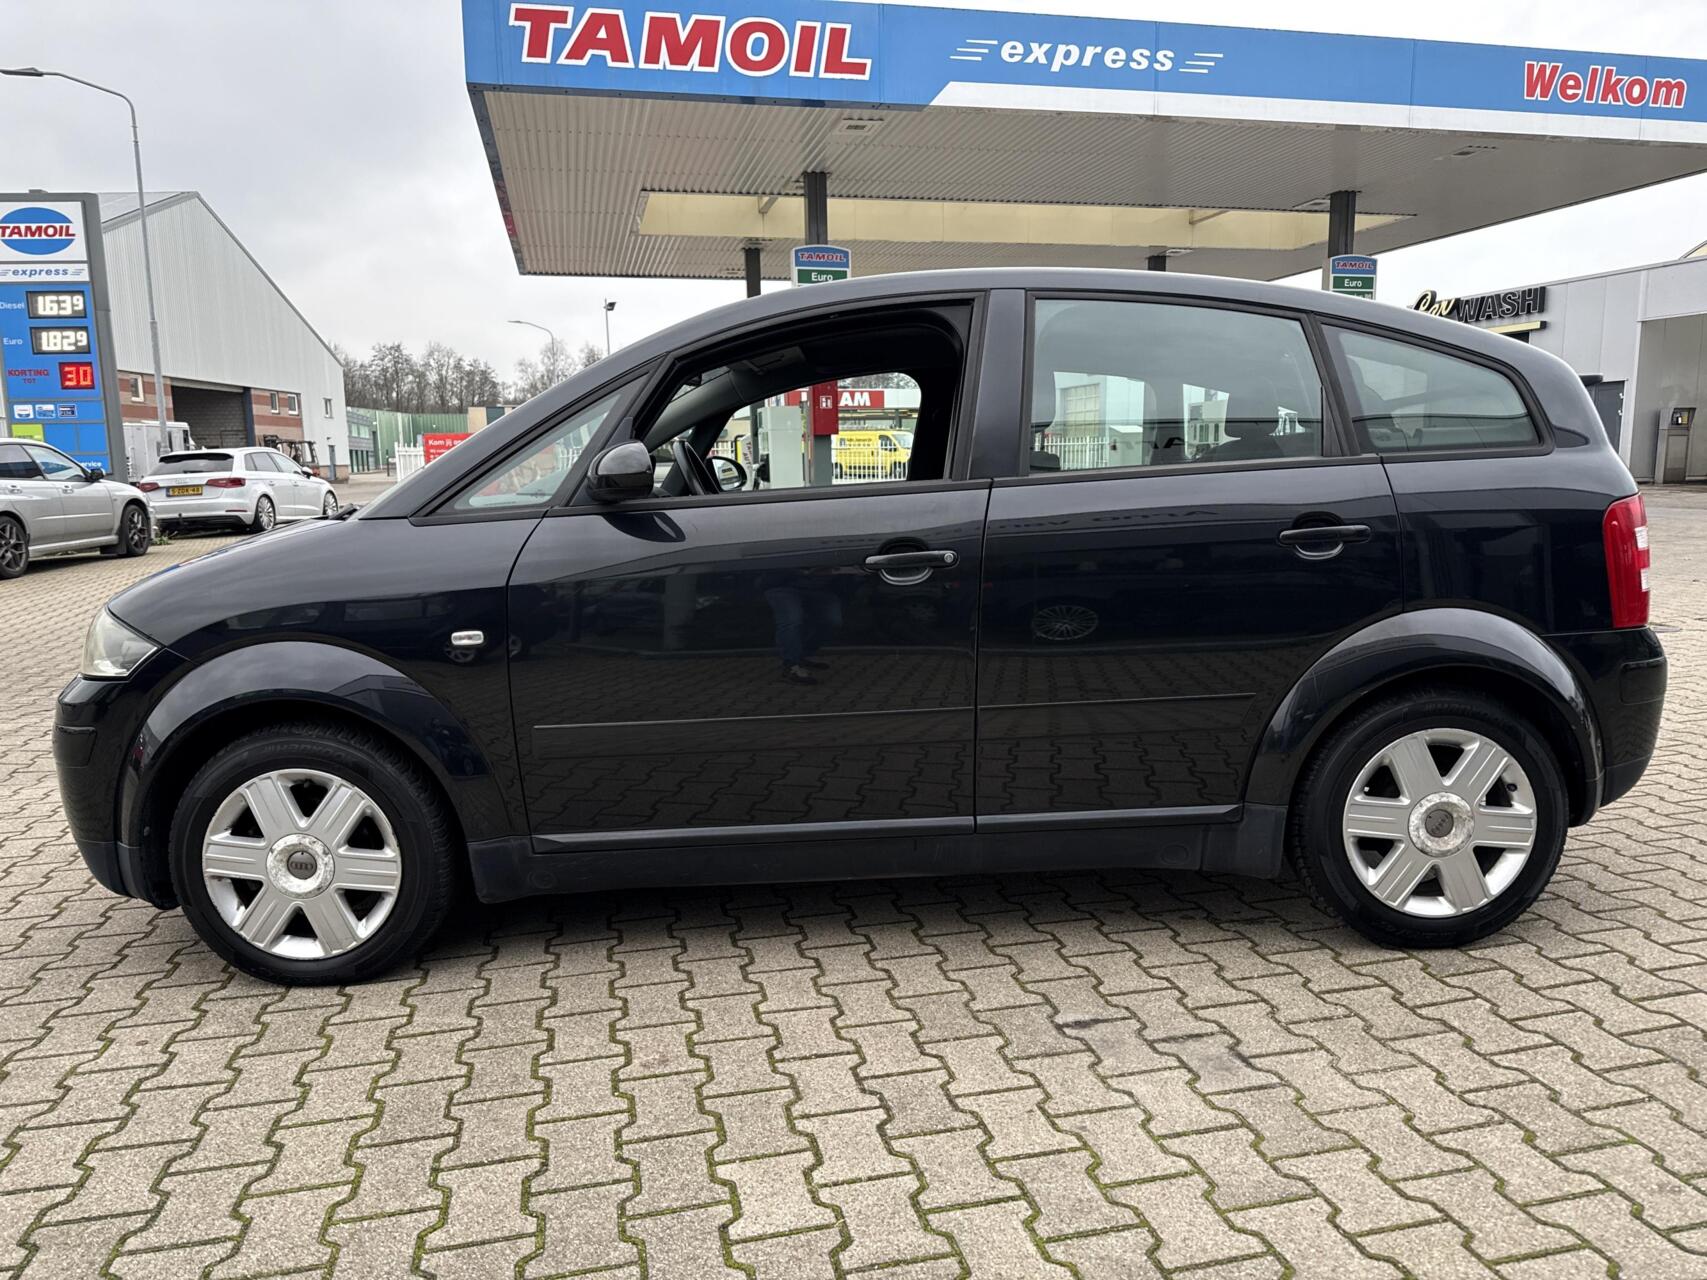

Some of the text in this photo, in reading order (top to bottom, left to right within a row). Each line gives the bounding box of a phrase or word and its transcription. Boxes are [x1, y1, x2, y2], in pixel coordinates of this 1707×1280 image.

[509, 3, 872, 80] TAMOIL
[1001, 39, 1174, 72] express
[1524, 61, 1687, 108] Welkom
[0, 225, 76, 238] TAMOIL
[798, 252, 846, 262] TAMOIL
[1335, 261, 1373, 269] TAMOIL
[12, 268, 69, 277] express
[812, 272, 833, 281] Euro
[1344, 279, 1362, 287] Euro
[1457, 286, 1545, 322] WASH
[3, 337, 23, 345] Euro
[64, 366, 92, 386] 30
